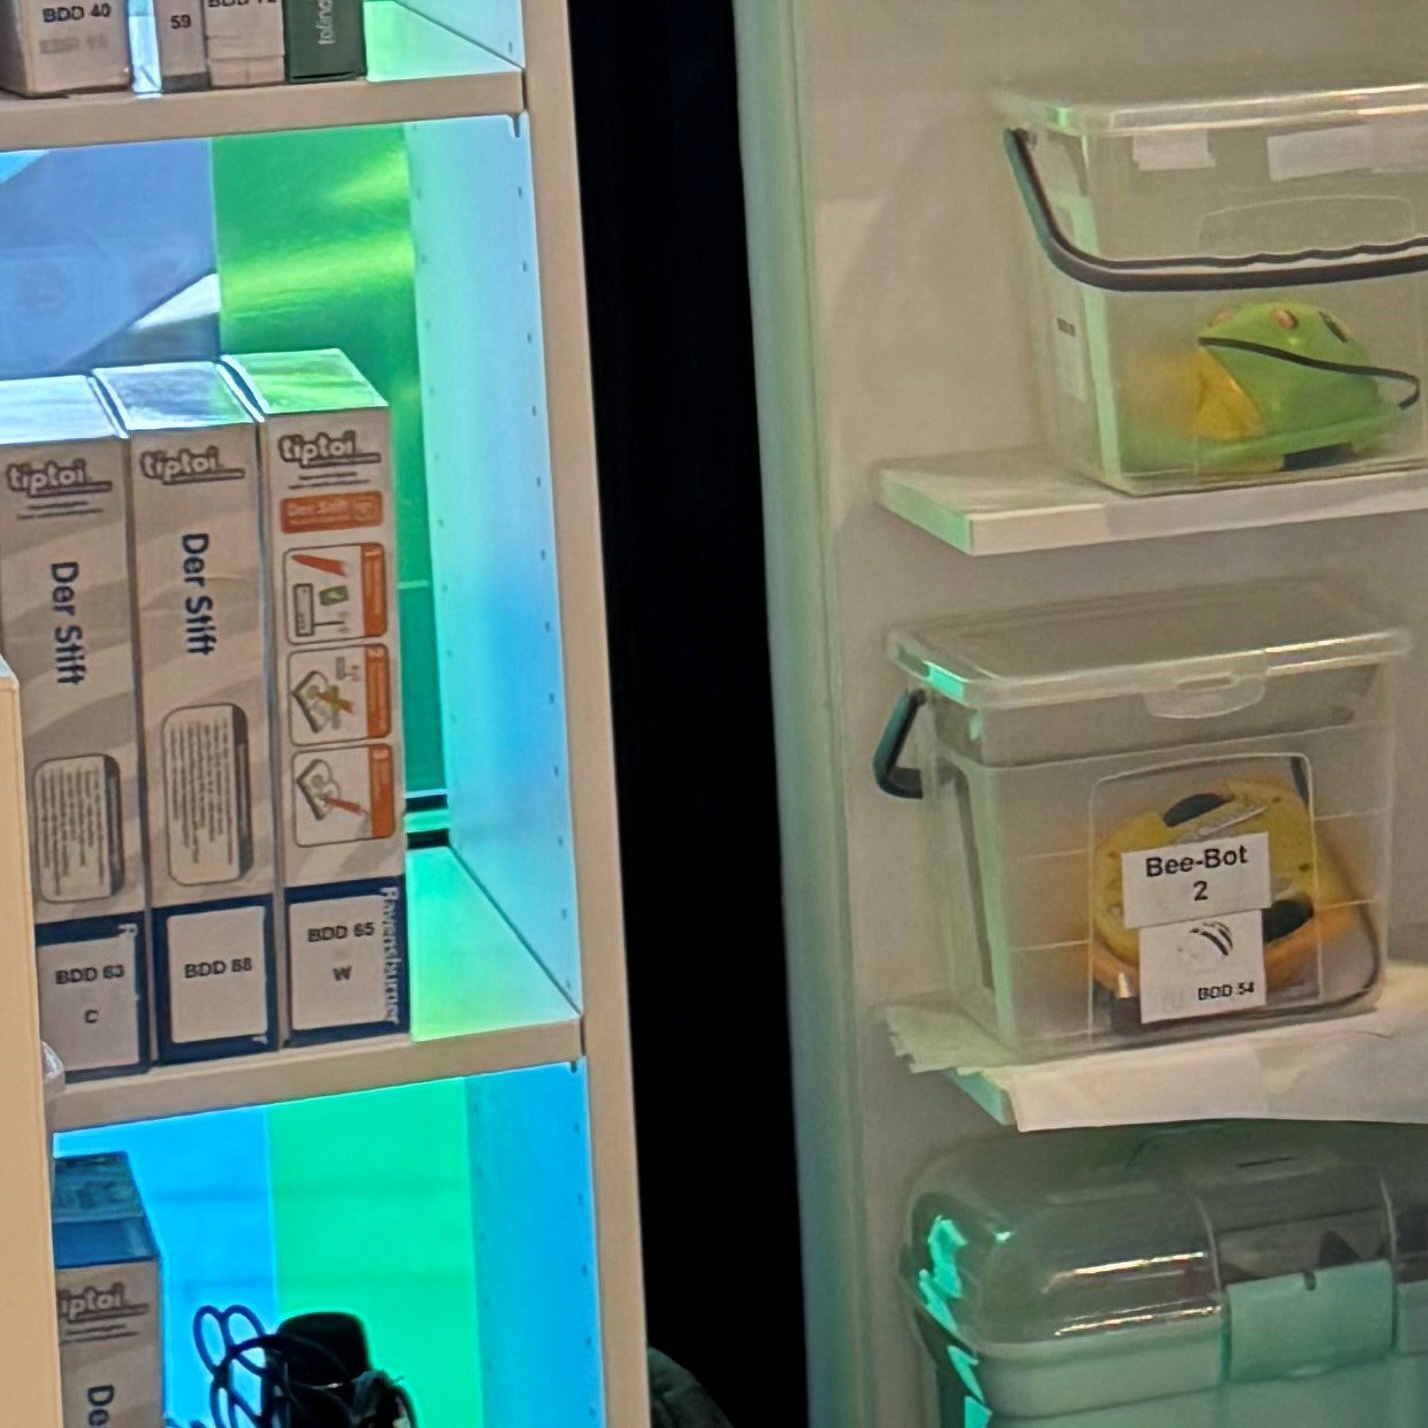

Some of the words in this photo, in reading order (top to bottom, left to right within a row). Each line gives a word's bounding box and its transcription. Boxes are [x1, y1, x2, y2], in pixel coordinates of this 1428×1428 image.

[42, 7, 85, 23] BDD
[90, 3, 112, 20] 40
[170, 14, 192, 30] 59
[279, 429, 358, 468] tiptoi
[6, 459, 89, 495] tiptoi
[140, 446, 220, 482] tiptoi
[181, 532, 210, 589] Der
[51, 561, 79, 618] Der
[185, 594, 218, 657] Stift
[54, 622, 88, 686] Stift
[1146, 845, 1248, 878] Bee-Bot
[1193, 880, 1209, 902] 2
[308, 925, 349, 943] BDD
[55, 968, 98, 986] BDD
[184, 962, 228, 980] BDD
[333, 965, 353, 981] W
[1198, 984, 1232, 1000] BDD
[84, 1008, 100, 1024] C
[59, 1283, 126, 1323] iptoi
